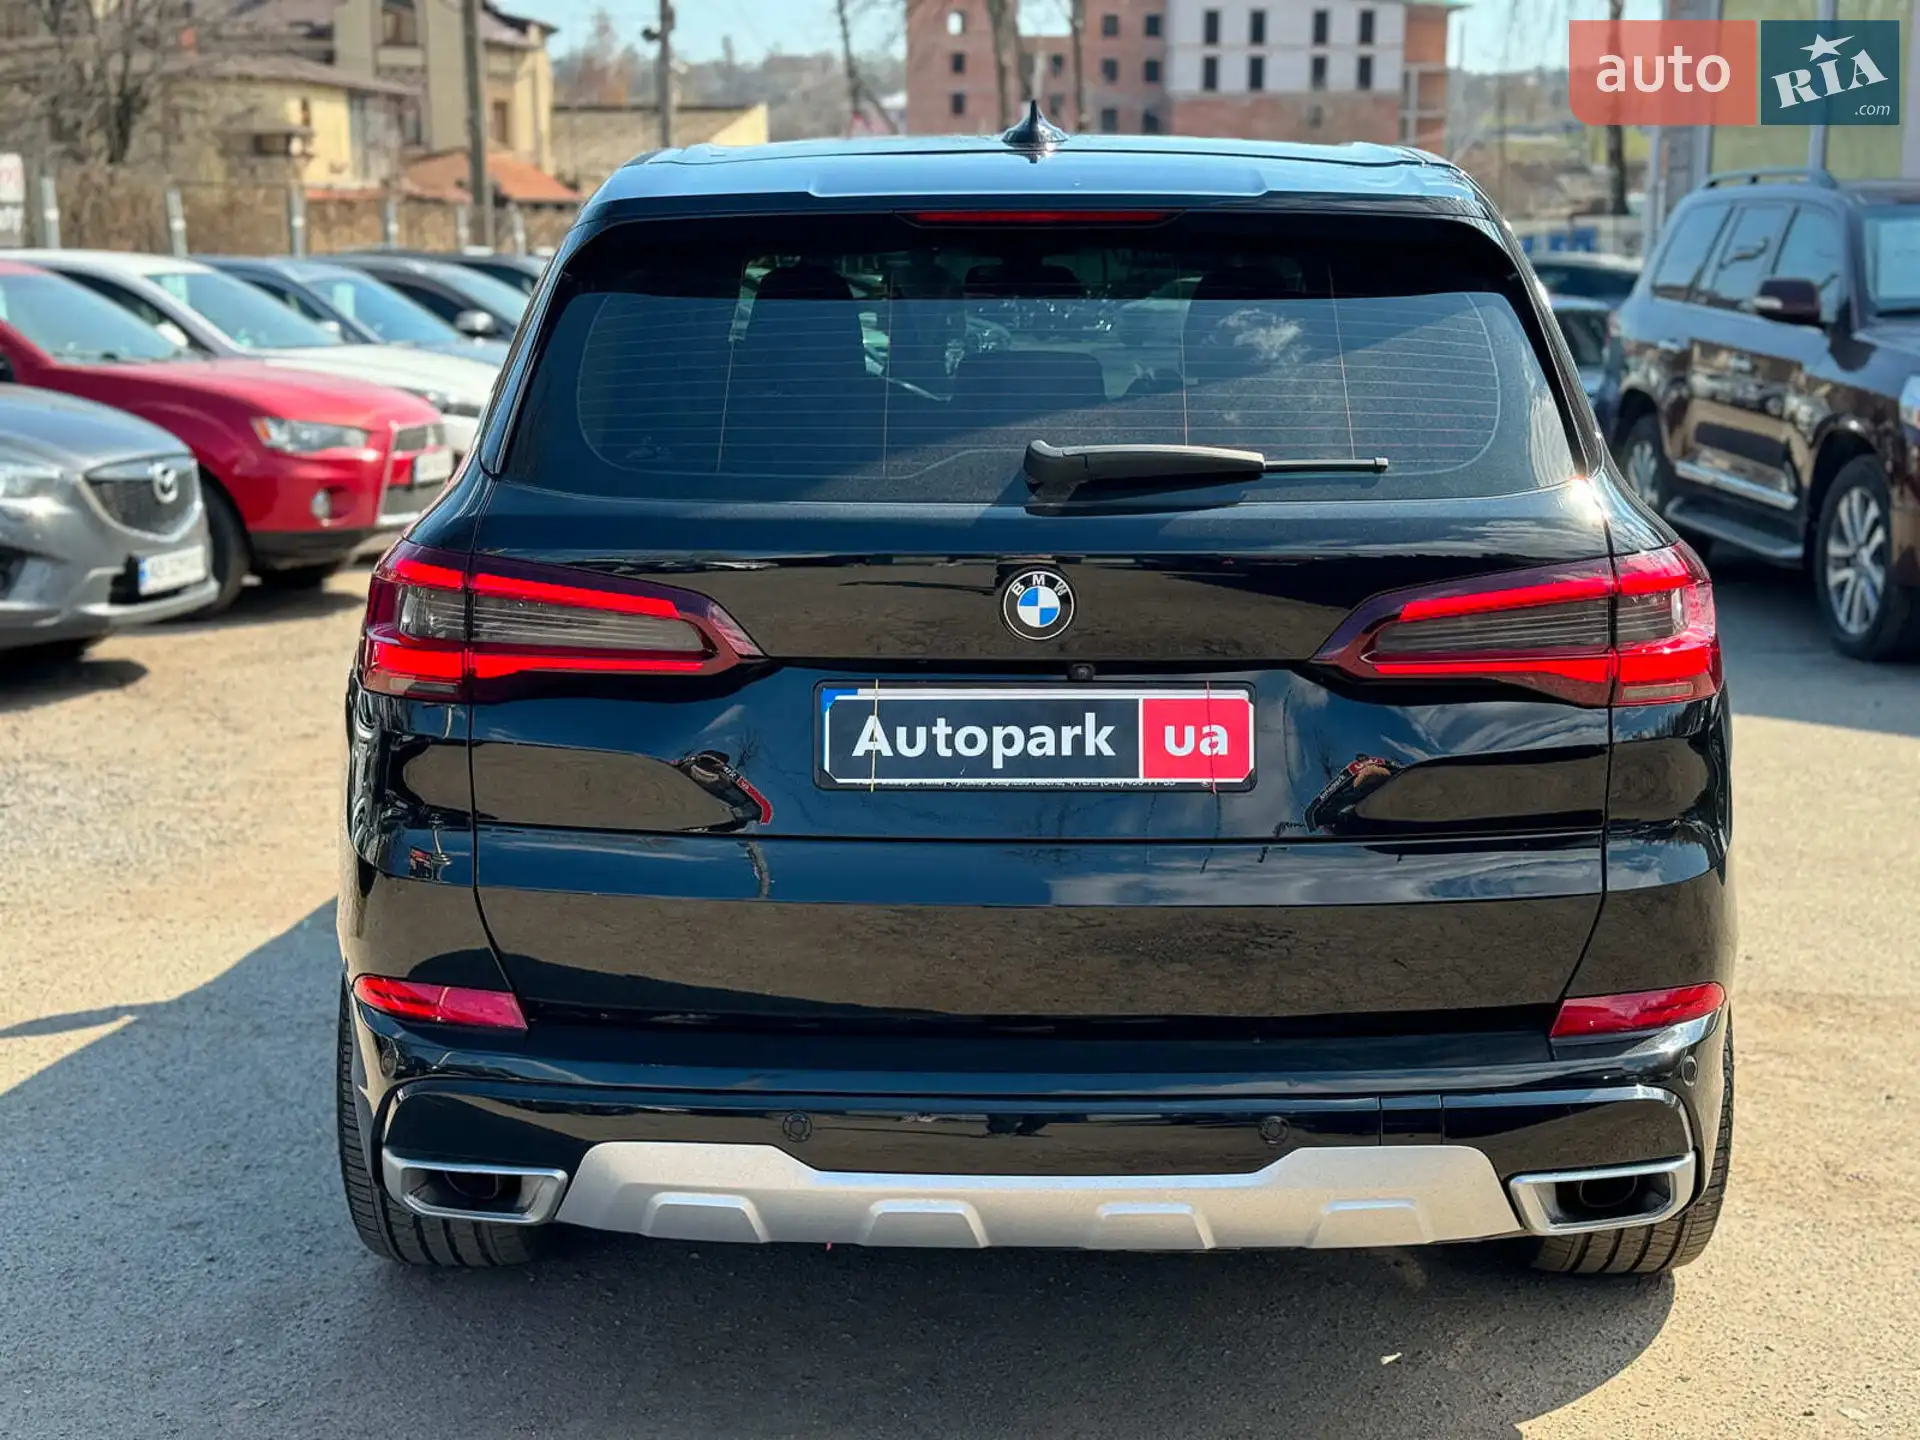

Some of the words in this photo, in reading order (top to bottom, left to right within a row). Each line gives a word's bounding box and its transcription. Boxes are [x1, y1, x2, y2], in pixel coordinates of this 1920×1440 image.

[1011, 574, 1068, 596] BMW
[851, 712, 1116, 769] Autopark
[1164, 724, 1229, 757] ua
